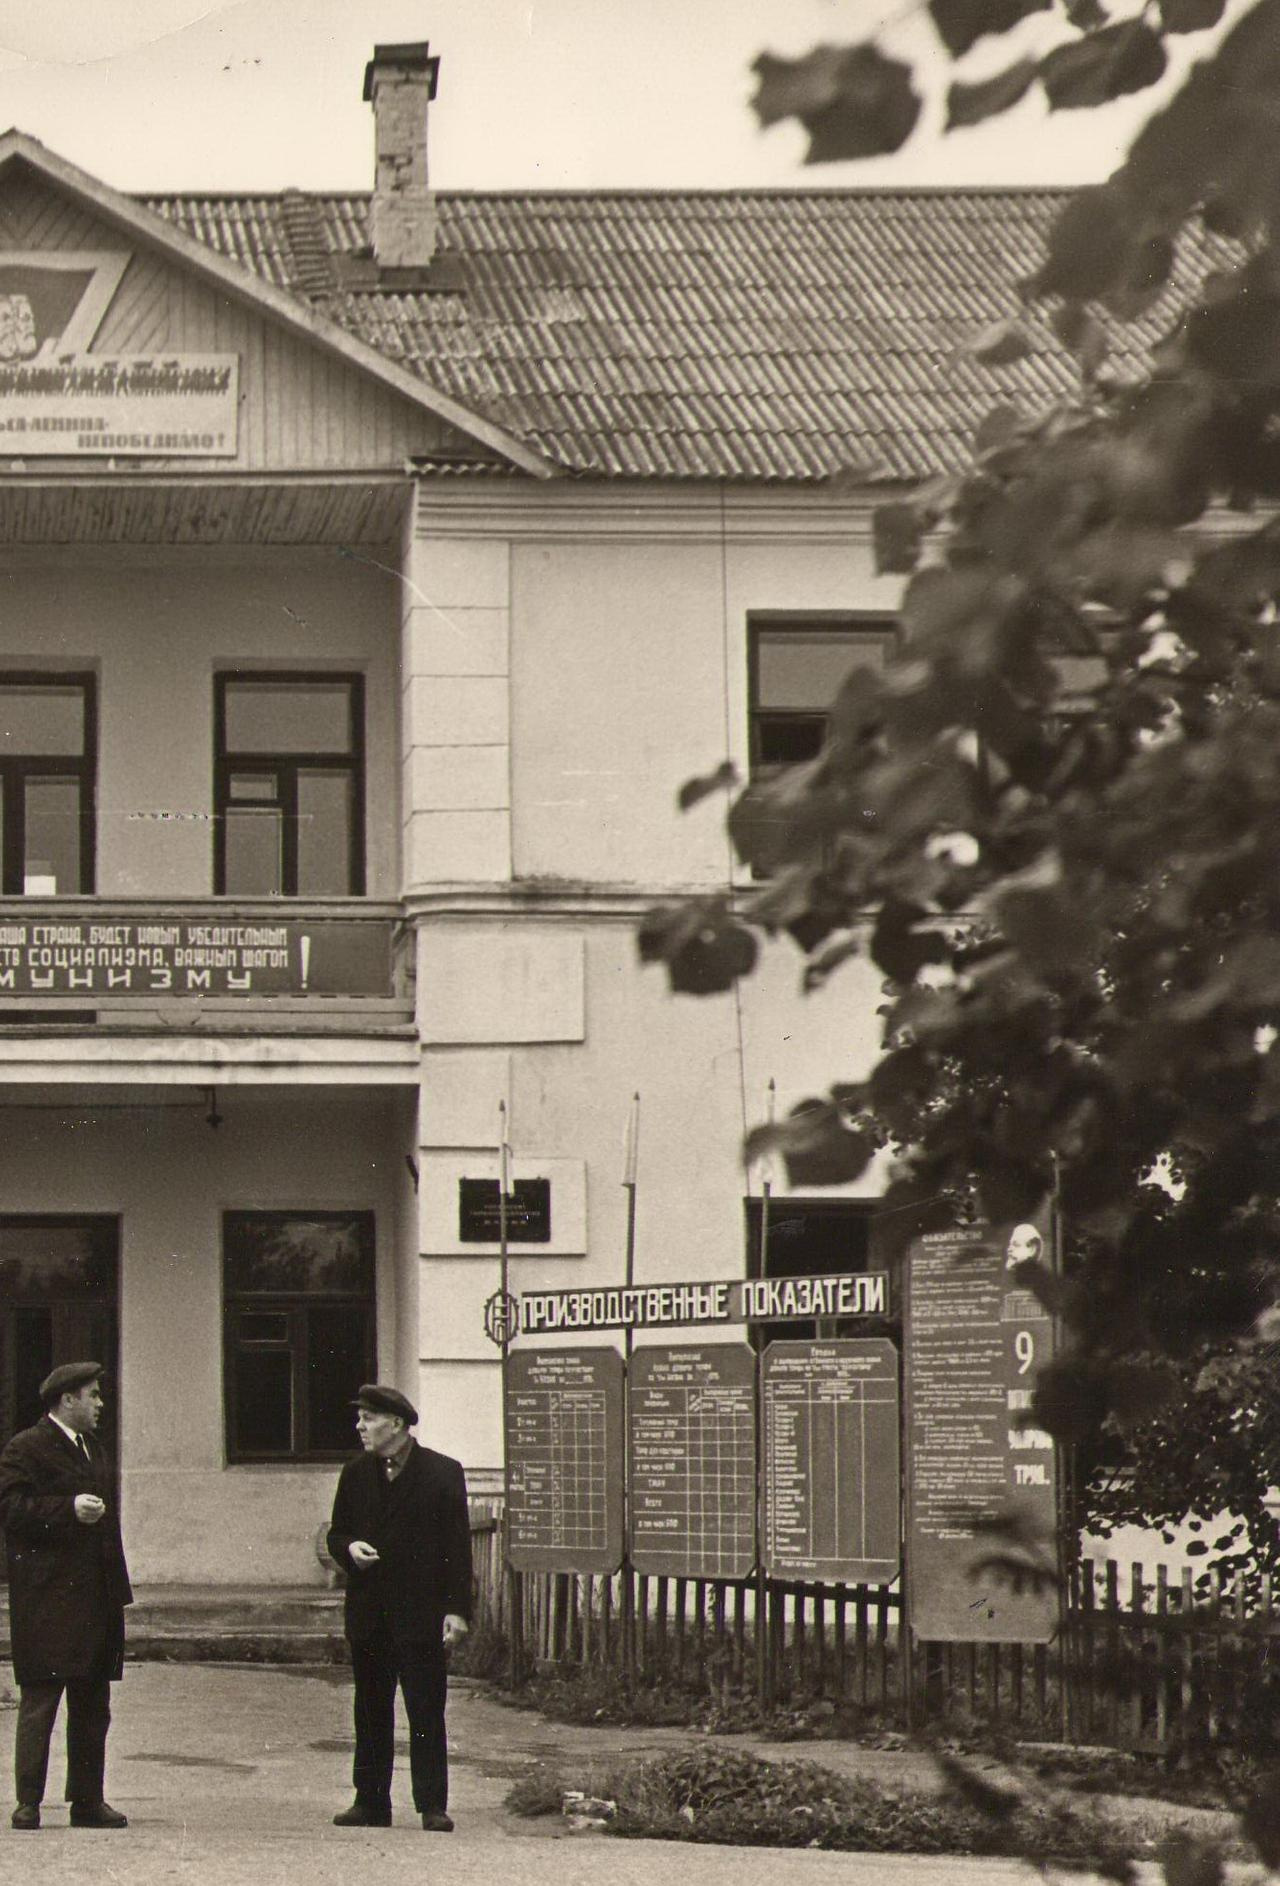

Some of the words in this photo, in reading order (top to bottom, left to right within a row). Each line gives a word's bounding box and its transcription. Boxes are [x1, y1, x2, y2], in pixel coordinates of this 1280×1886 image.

[90, 926, 131, 945] БУДЕТ
[138, 926, 180, 945] НОВЫМ
[188, 927, 288, 947] УБЕДИТЕЛЬНЫМ
[28, 948, 169, 969] СОЦИАЛИЗМА,
[174, 948, 237, 967] ВАЖНЫМ
[242, 949, 288, 968] ШАГОМ
[522, 1284, 728, 1329] ПРОИЗВОДСТВЕННЫЕ
[741, 1276, 885, 1317] ПОКАЗАТЕЛИ
[1015, 1331, 1034, 1375] 9
